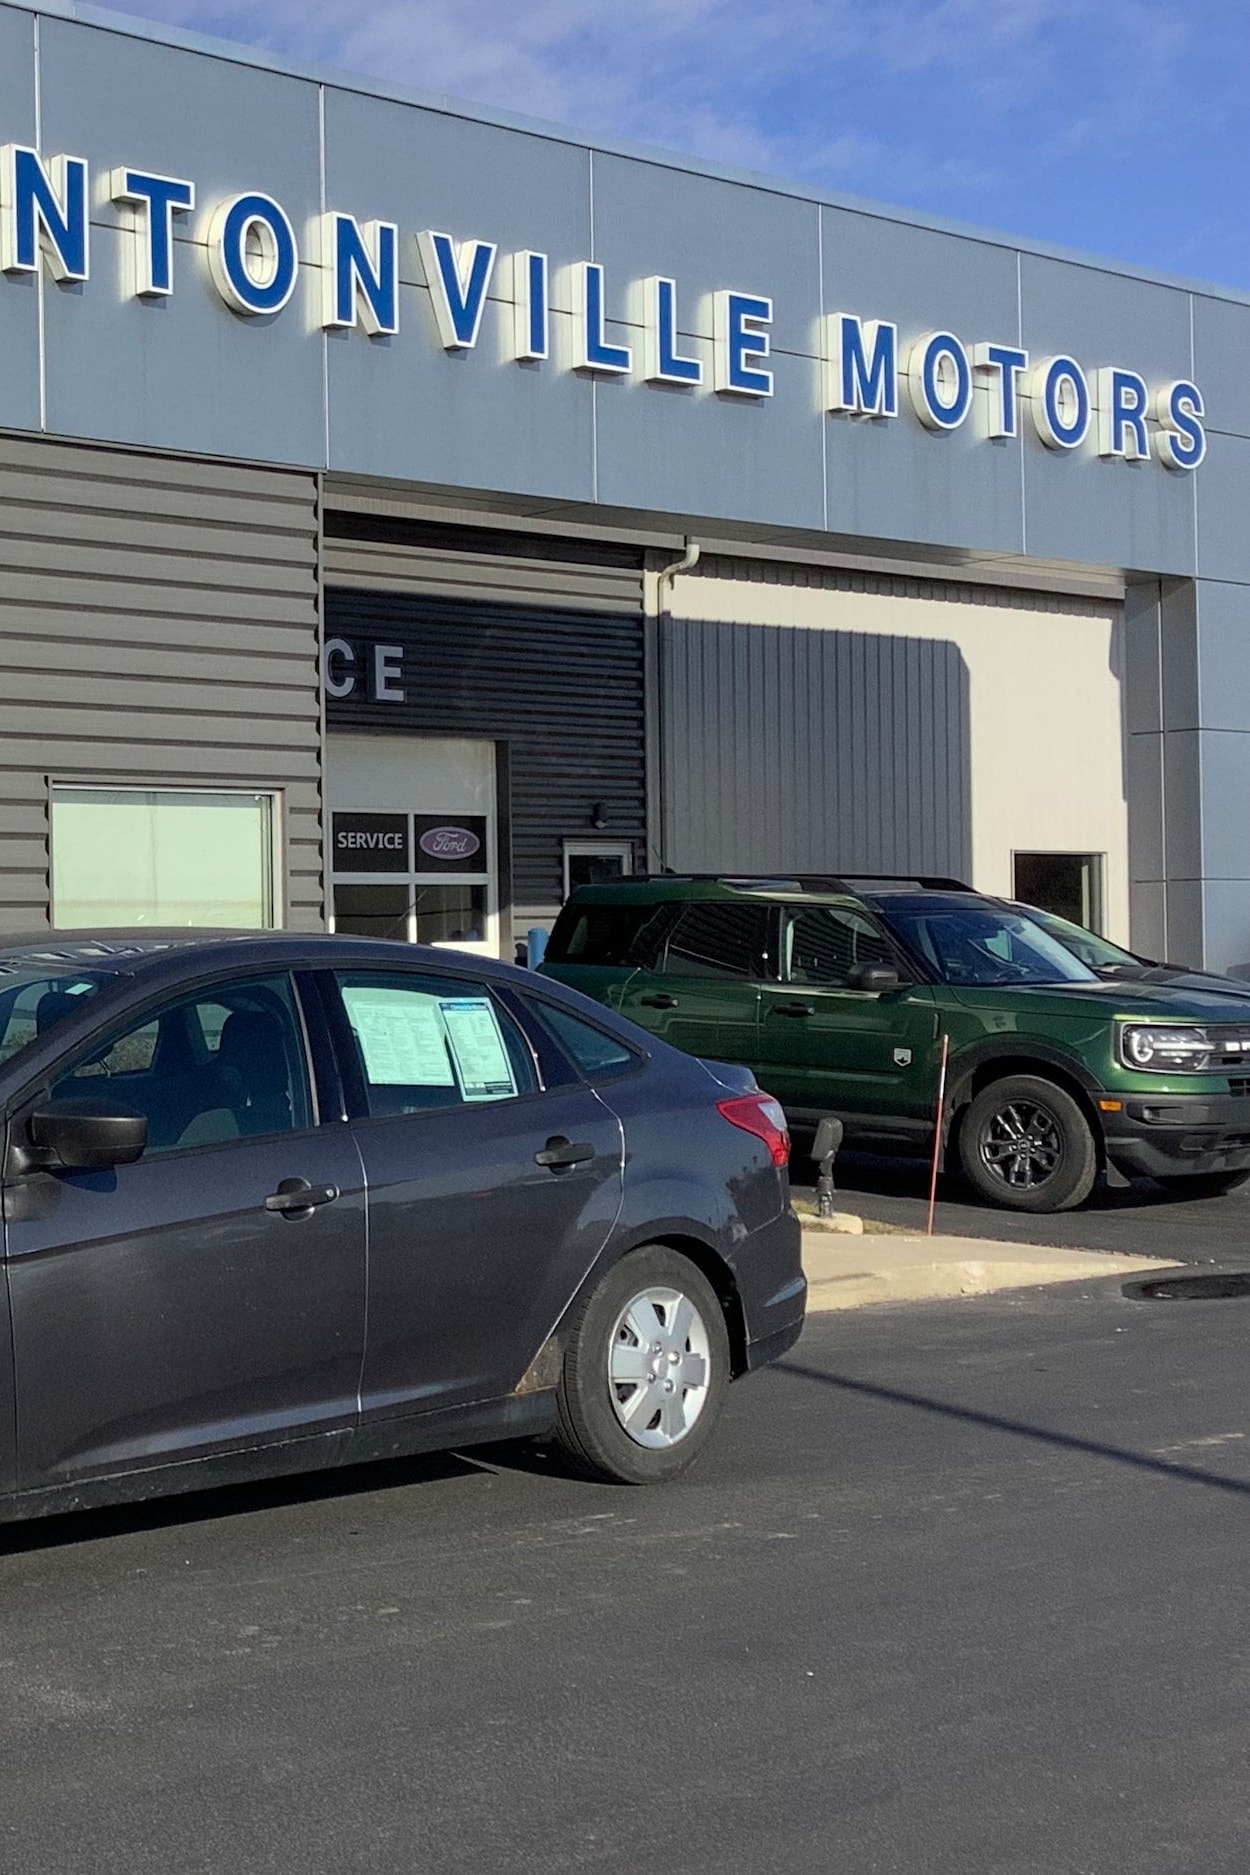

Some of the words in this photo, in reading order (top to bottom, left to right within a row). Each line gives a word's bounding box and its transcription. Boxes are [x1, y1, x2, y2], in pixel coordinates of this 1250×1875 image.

[826, 312, 1208, 471] MOTORS
[337, 831, 403, 849] SERVICE
[432, 831, 468, 853] Ford
